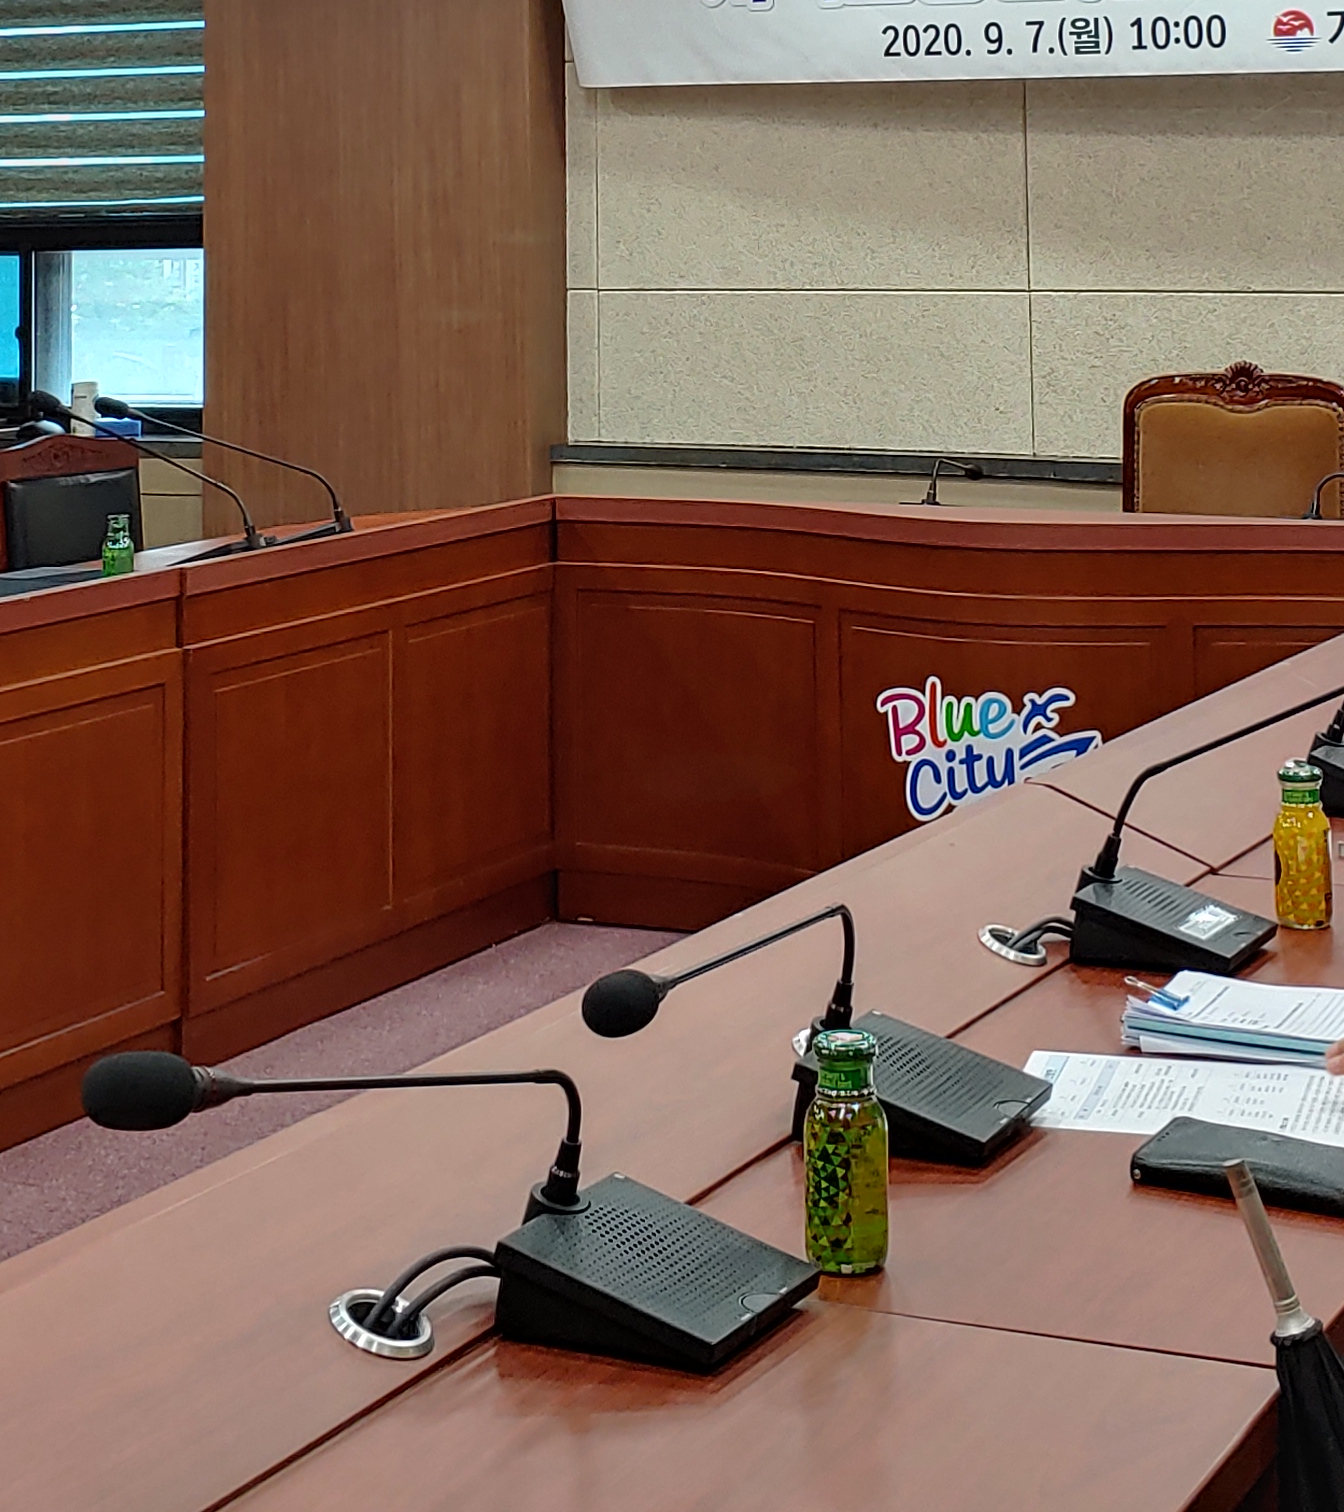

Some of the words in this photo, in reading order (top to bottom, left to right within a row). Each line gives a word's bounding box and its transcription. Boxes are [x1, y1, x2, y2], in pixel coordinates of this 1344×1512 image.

[881, 23, 972, 57] 2020.
[983, 21, 1013, 56] 9.
[1129, 14, 1227, 51] 10:00
[880, 680, 1016, 757] Blue
[909, 743, 1016, 816] City
